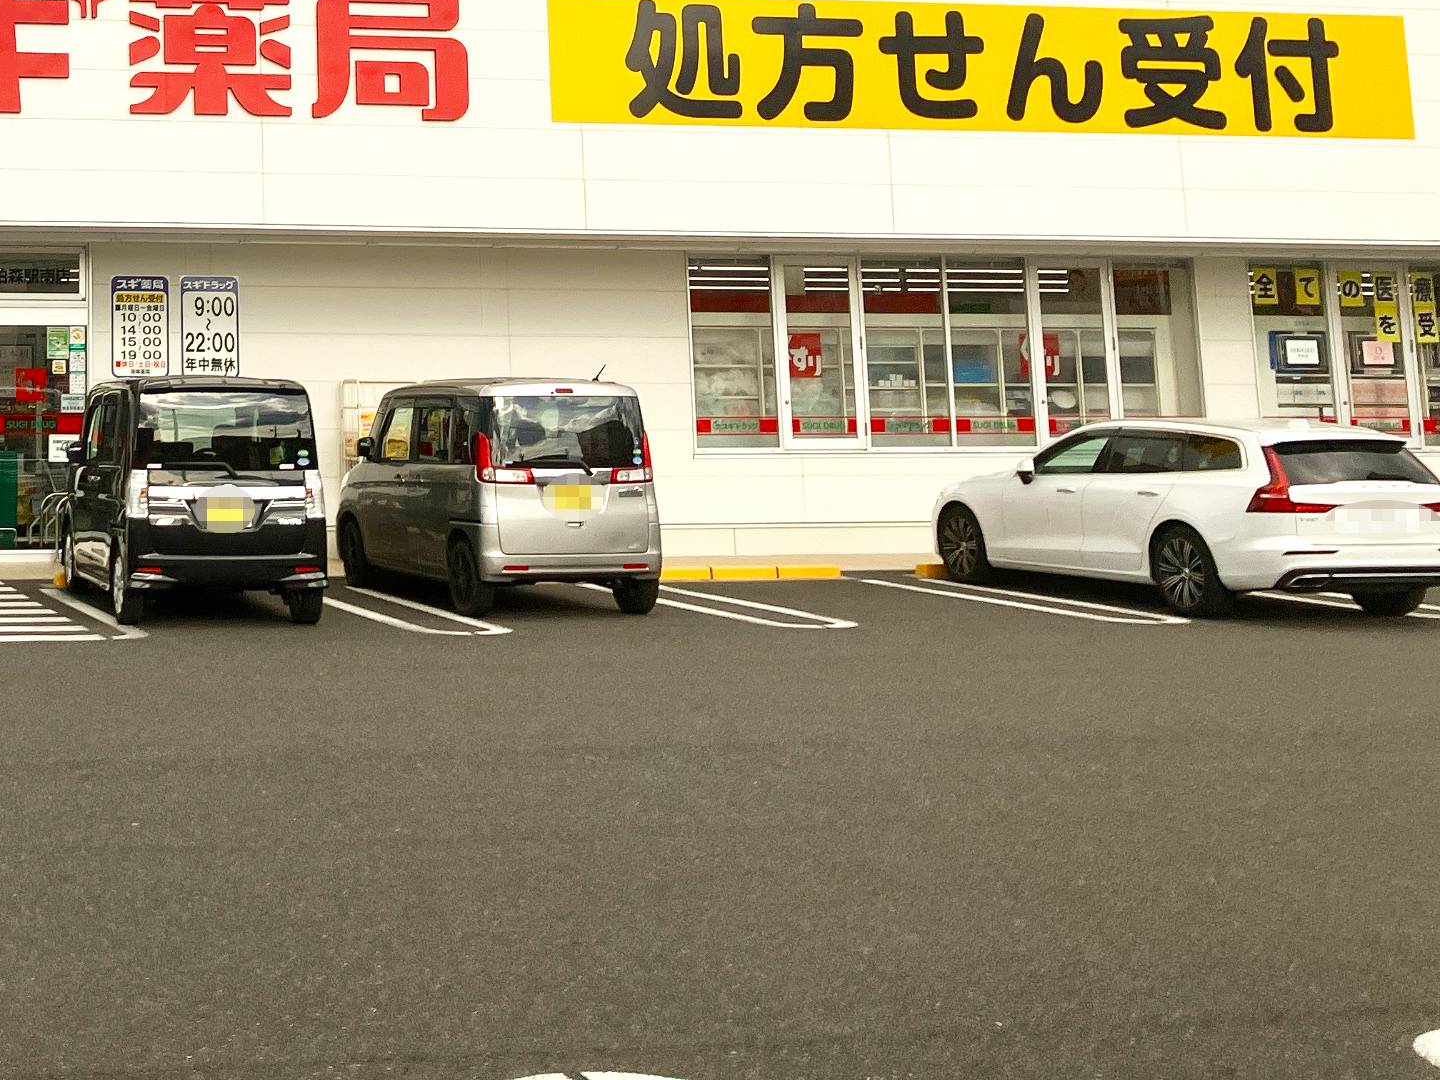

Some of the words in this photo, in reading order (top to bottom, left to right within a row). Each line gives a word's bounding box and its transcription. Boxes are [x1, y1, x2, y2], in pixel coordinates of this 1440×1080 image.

[625, 0, 1340, 132] 処方せん受付
[116, 278, 164, 290] スギ薬局
[183, 280, 235, 290] スギドラッグ
[116, 294, 163, 303] 処方せん受付
[194, 296, 235, 317] 9:00
[121, 312, 162, 322] 10:00
[121, 325, 162, 335] 14:00
[121, 337, 162, 347] 15:00
[185, 332, 235, 353] 22:00
[121, 350, 162, 360] 19:00
[789, 335, 821, 376] すり
[185, 357, 236, 372] 年中無休
[6, 421, 28, 429] SUGI
